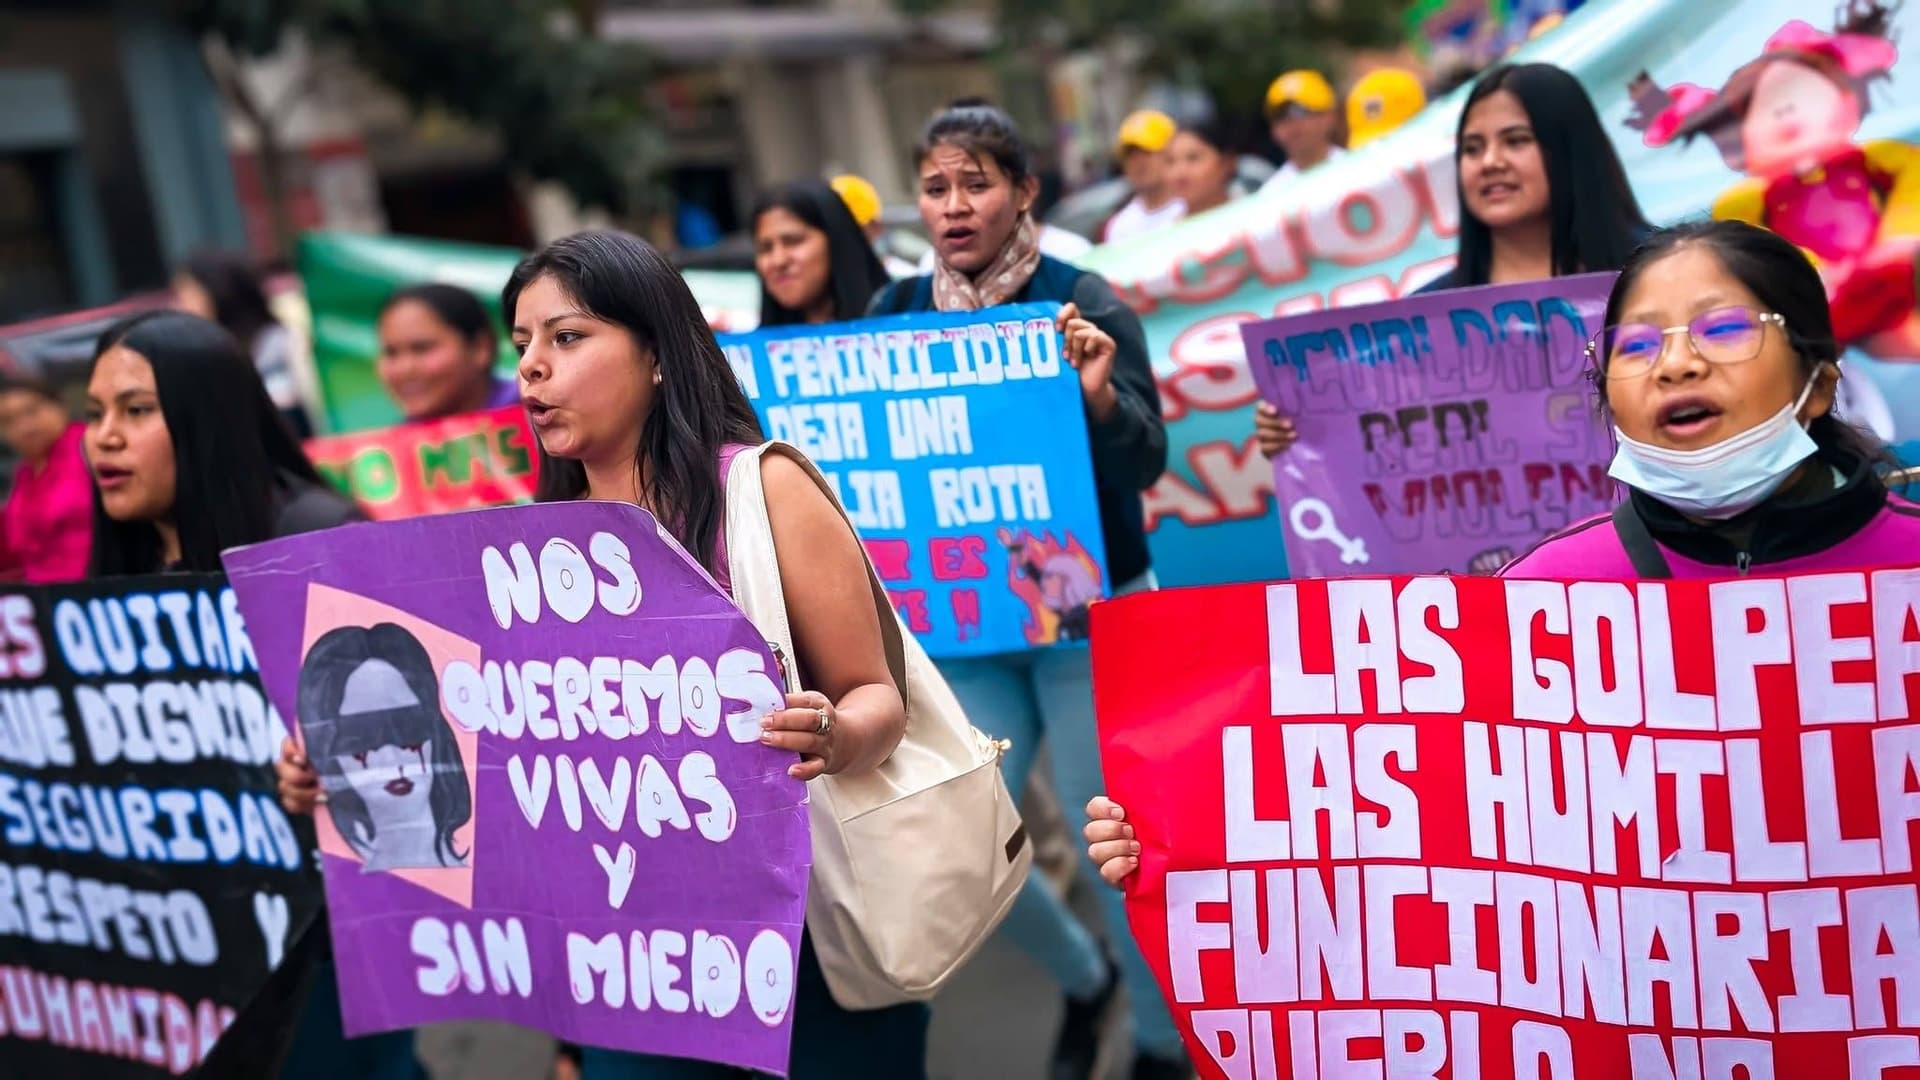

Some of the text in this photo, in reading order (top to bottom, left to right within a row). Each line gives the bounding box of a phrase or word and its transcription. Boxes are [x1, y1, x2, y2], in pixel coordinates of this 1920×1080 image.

[765, 317, 1060, 398] FEMINICIDIO
[766, 395, 974, 461] DEJA UNA
[1358, 397, 1518, 478] REAL
[929, 464, 1052, 528] ROTA
[481, 531, 643, 630] NOS
[928, 535, 989, 582] ES
[53, 587, 259, 675] QUITAR
[1266, 569, 1920, 732] LAS GOLPEA
[0, 683, 76, 768] UE
[441, 647, 786, 743] QUEREMOS
[0, 773, 300, 870] SEGURIDAD
[507, 751, 737, 842] VIVAS
[1222, 720, 1920, 885] LAS HUMILLA
[593, 841, 636, 909] Y
[254, 890, 291, 972] Y
[410, 917, 793, 1027] SIN MIEDO
[1166, 865, 1920, 1034] FUNCIONARIA
[0, 963, 236, 1076] UMANIDA
